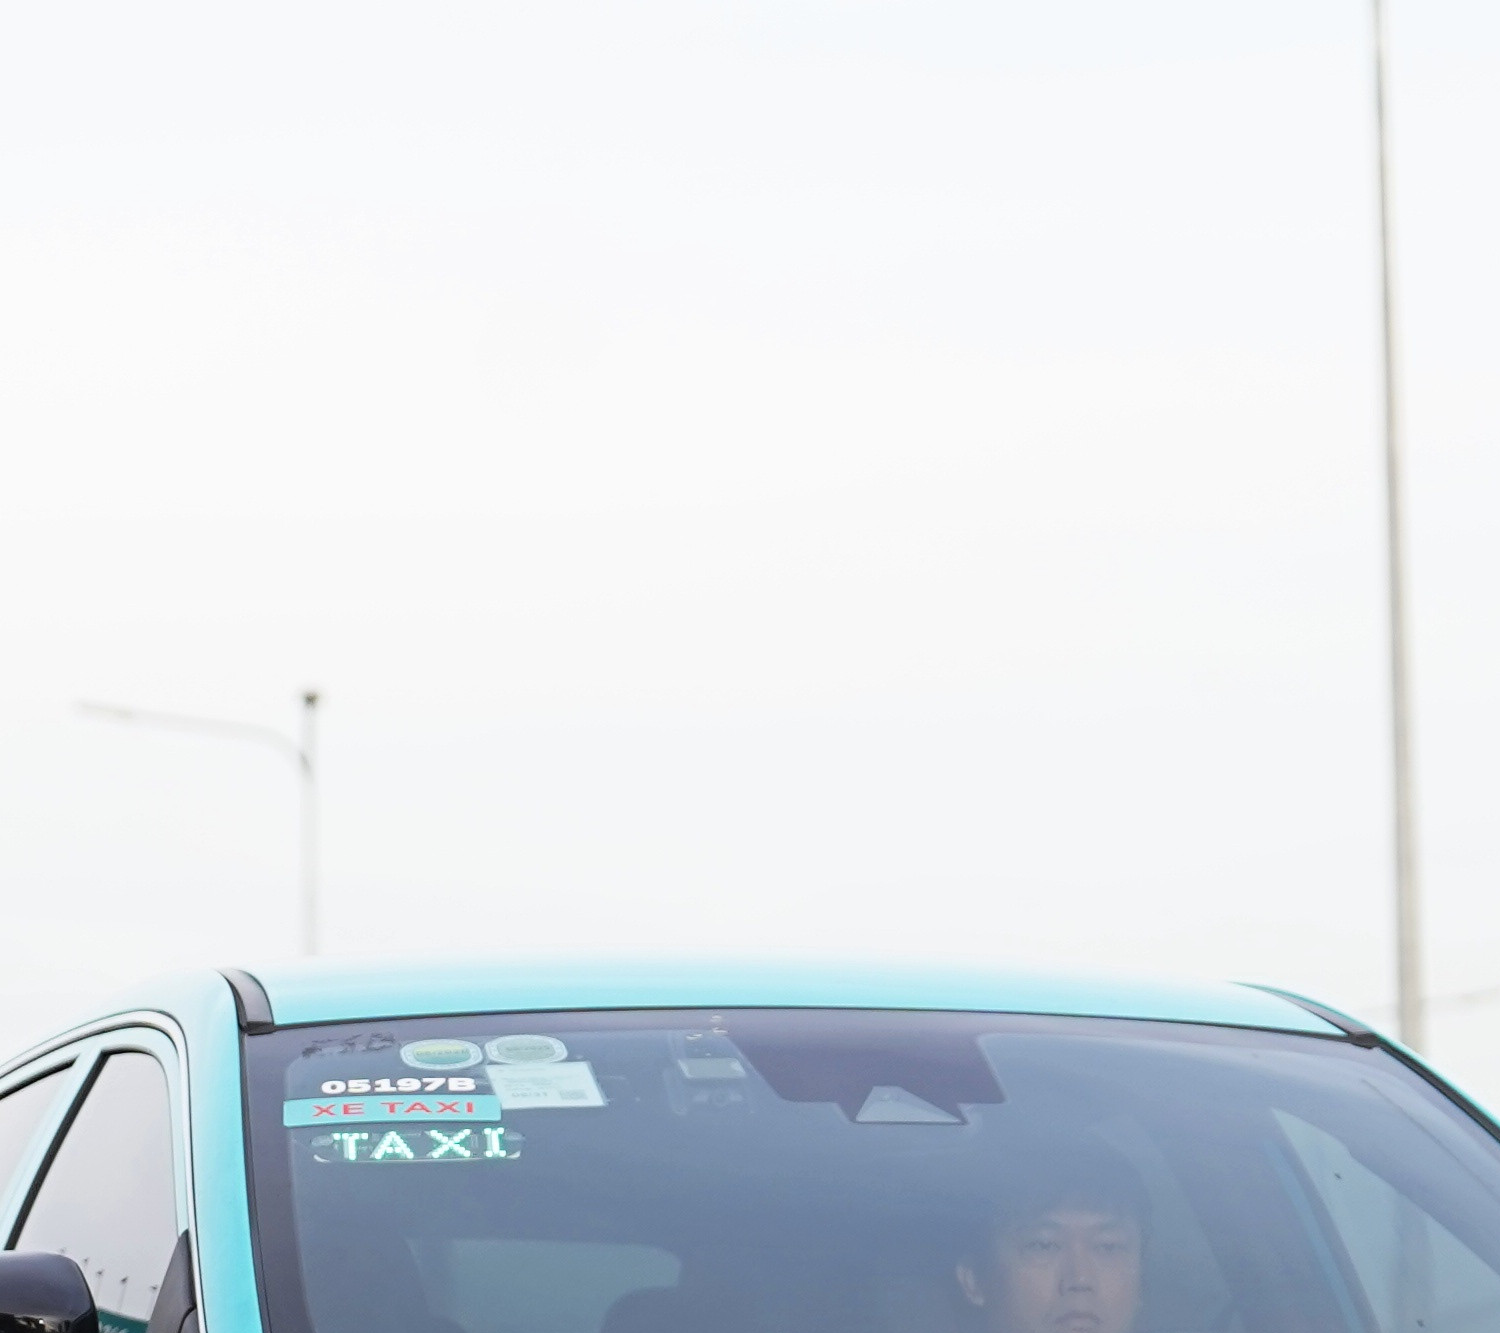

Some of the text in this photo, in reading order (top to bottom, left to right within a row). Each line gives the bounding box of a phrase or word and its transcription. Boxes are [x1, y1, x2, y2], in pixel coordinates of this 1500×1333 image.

[312, 1101, 475, 1117] XE TAXI
[332, 1126, 507, 1161] TAXI
